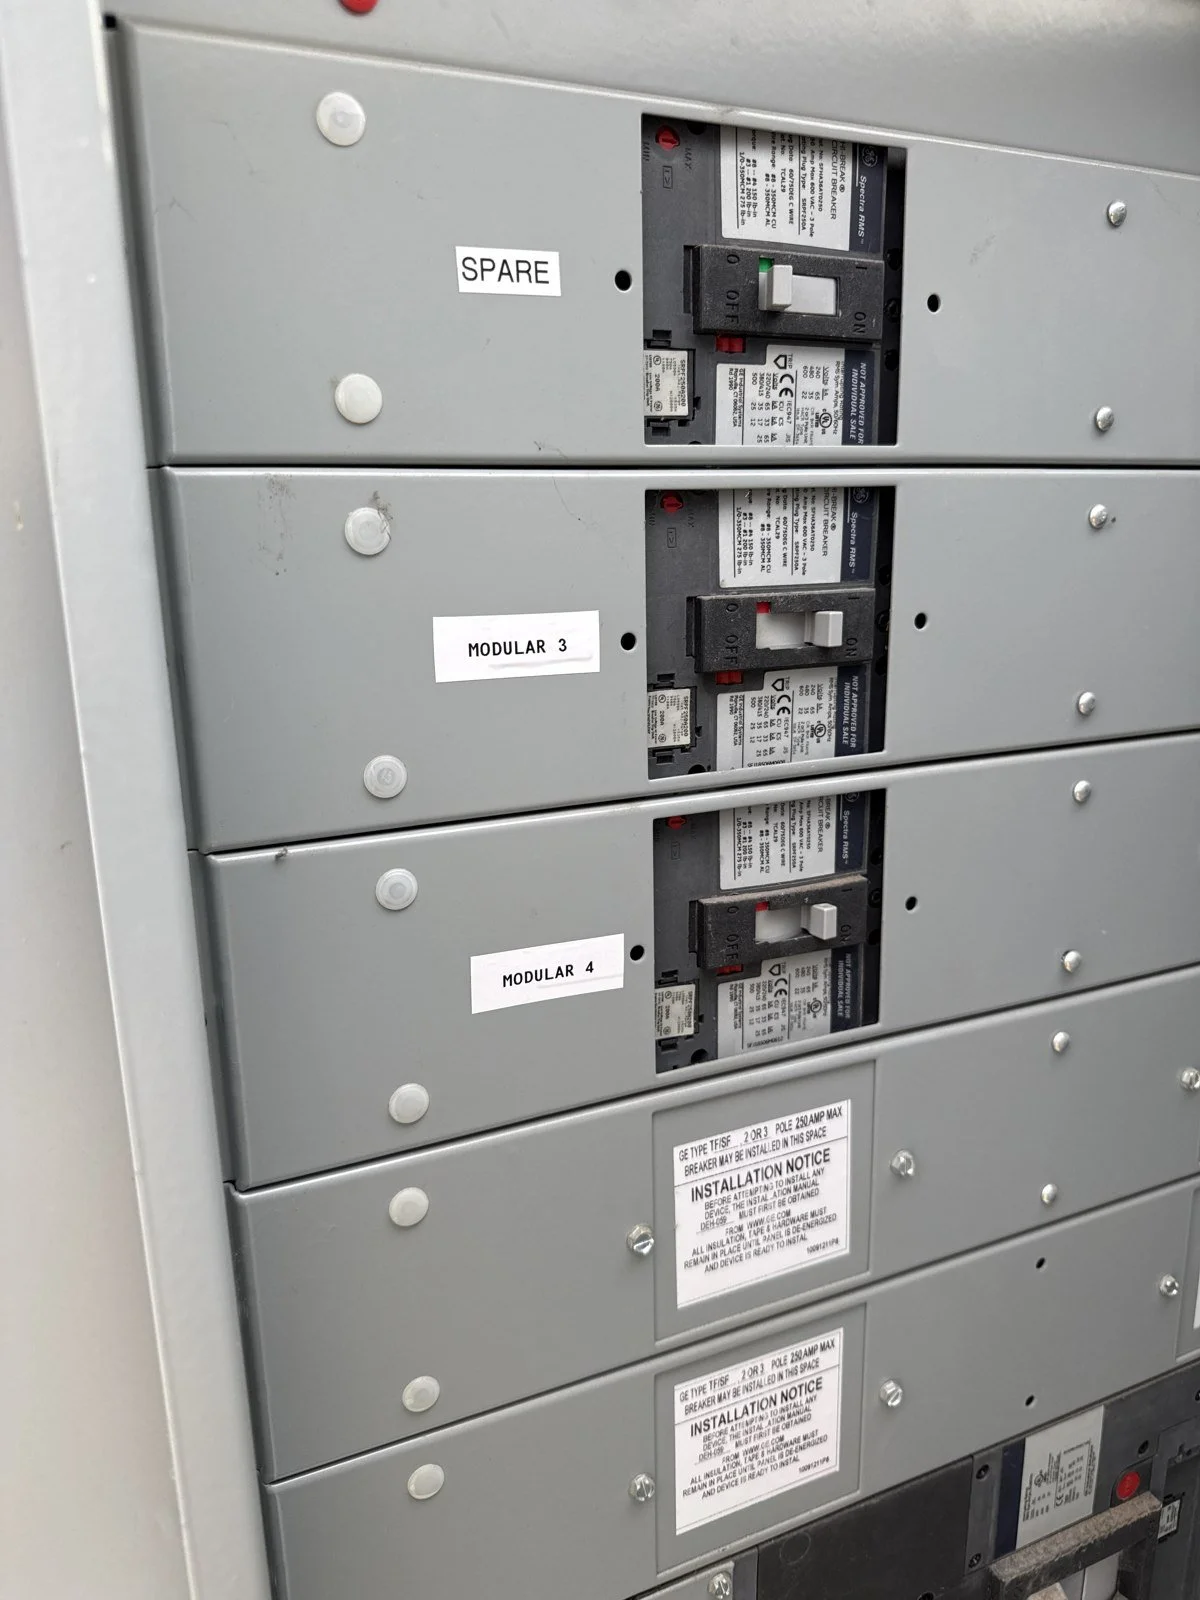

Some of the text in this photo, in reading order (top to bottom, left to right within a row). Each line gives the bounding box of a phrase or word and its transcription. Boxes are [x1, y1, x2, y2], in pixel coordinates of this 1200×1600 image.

[746, 159, 751, 167] #3
[752, 159, 757, 168] #8
[765, 173, 770, 182] #8
[771, 174, 776, 182] #8
[746, 177, 751, 186] #1
[752, 178, 757, 186] #4
[858, 176, 866, 212] Spectra
[771, 220, 776, 228] CU
[462, 257, 550, 284] SPARE
[726, 290, 739, 324] OFF
[852, 312, 866, 334] ON
[468, 638, 568, 657] MODULAR 3
[725, 634, 739, 666] OFF
[845, 638, 858, 658] ON
[726, 934, 739, 962] OFF
[503, 961, 594, 987] MODULAR 4
[679, 1105, 841, 1161] GE TYPE TF/SF 2 OR 3 POLE 250 AMP MAX
[684, 1125, 826, 1176] BREAKER MAY BE INSTALLED IN THIS SPACE
[691, 1147, 830, 1202] INSTALLATION NOTICE
[704, 1166, 824, 1210] BEFORE ATTEMPTING TO INSTALL ANY
[704, 1204, 730, 1221] DEVICE,
[732, 1200, 744, 1211] THE
[793, 1177, 818, 1192] MANUAL
[738, 1206, 755, 1219] MUST
[758, 1200, 775, 1213] FIRST
[777, 1197, 785, 1207] BE
[788, 1187, 819, 1204] OBTAINED
[683, 1212, 836, 1269] REMAIN IN PLACE UNTIL PANEL IS DE-ENERGIZED
[692, 1206, 826, 1256] ALL INSULATION, TAPE & HARDWARE MUST
[725, 1223, 743, 1236] FROM
[704, 1261, 718, 1273] AND
[720, 1253, 742, 1268] DEVICE
[745, 1250, 751, 1260] IS
[753, 1243, 773, 1257] READY
[776, 1239, 784, 1249] TO
[679, 1338, 834, 1402] GE TYPE TF/SF 2 OR 3 POLE 250 AMP MAX
[684, 1357, 819, 1414] BREAKER MAY BE INSTALLED IN THIS SPACE
[690, 1376, 822, 1437] INSTALLATION NOTICE
